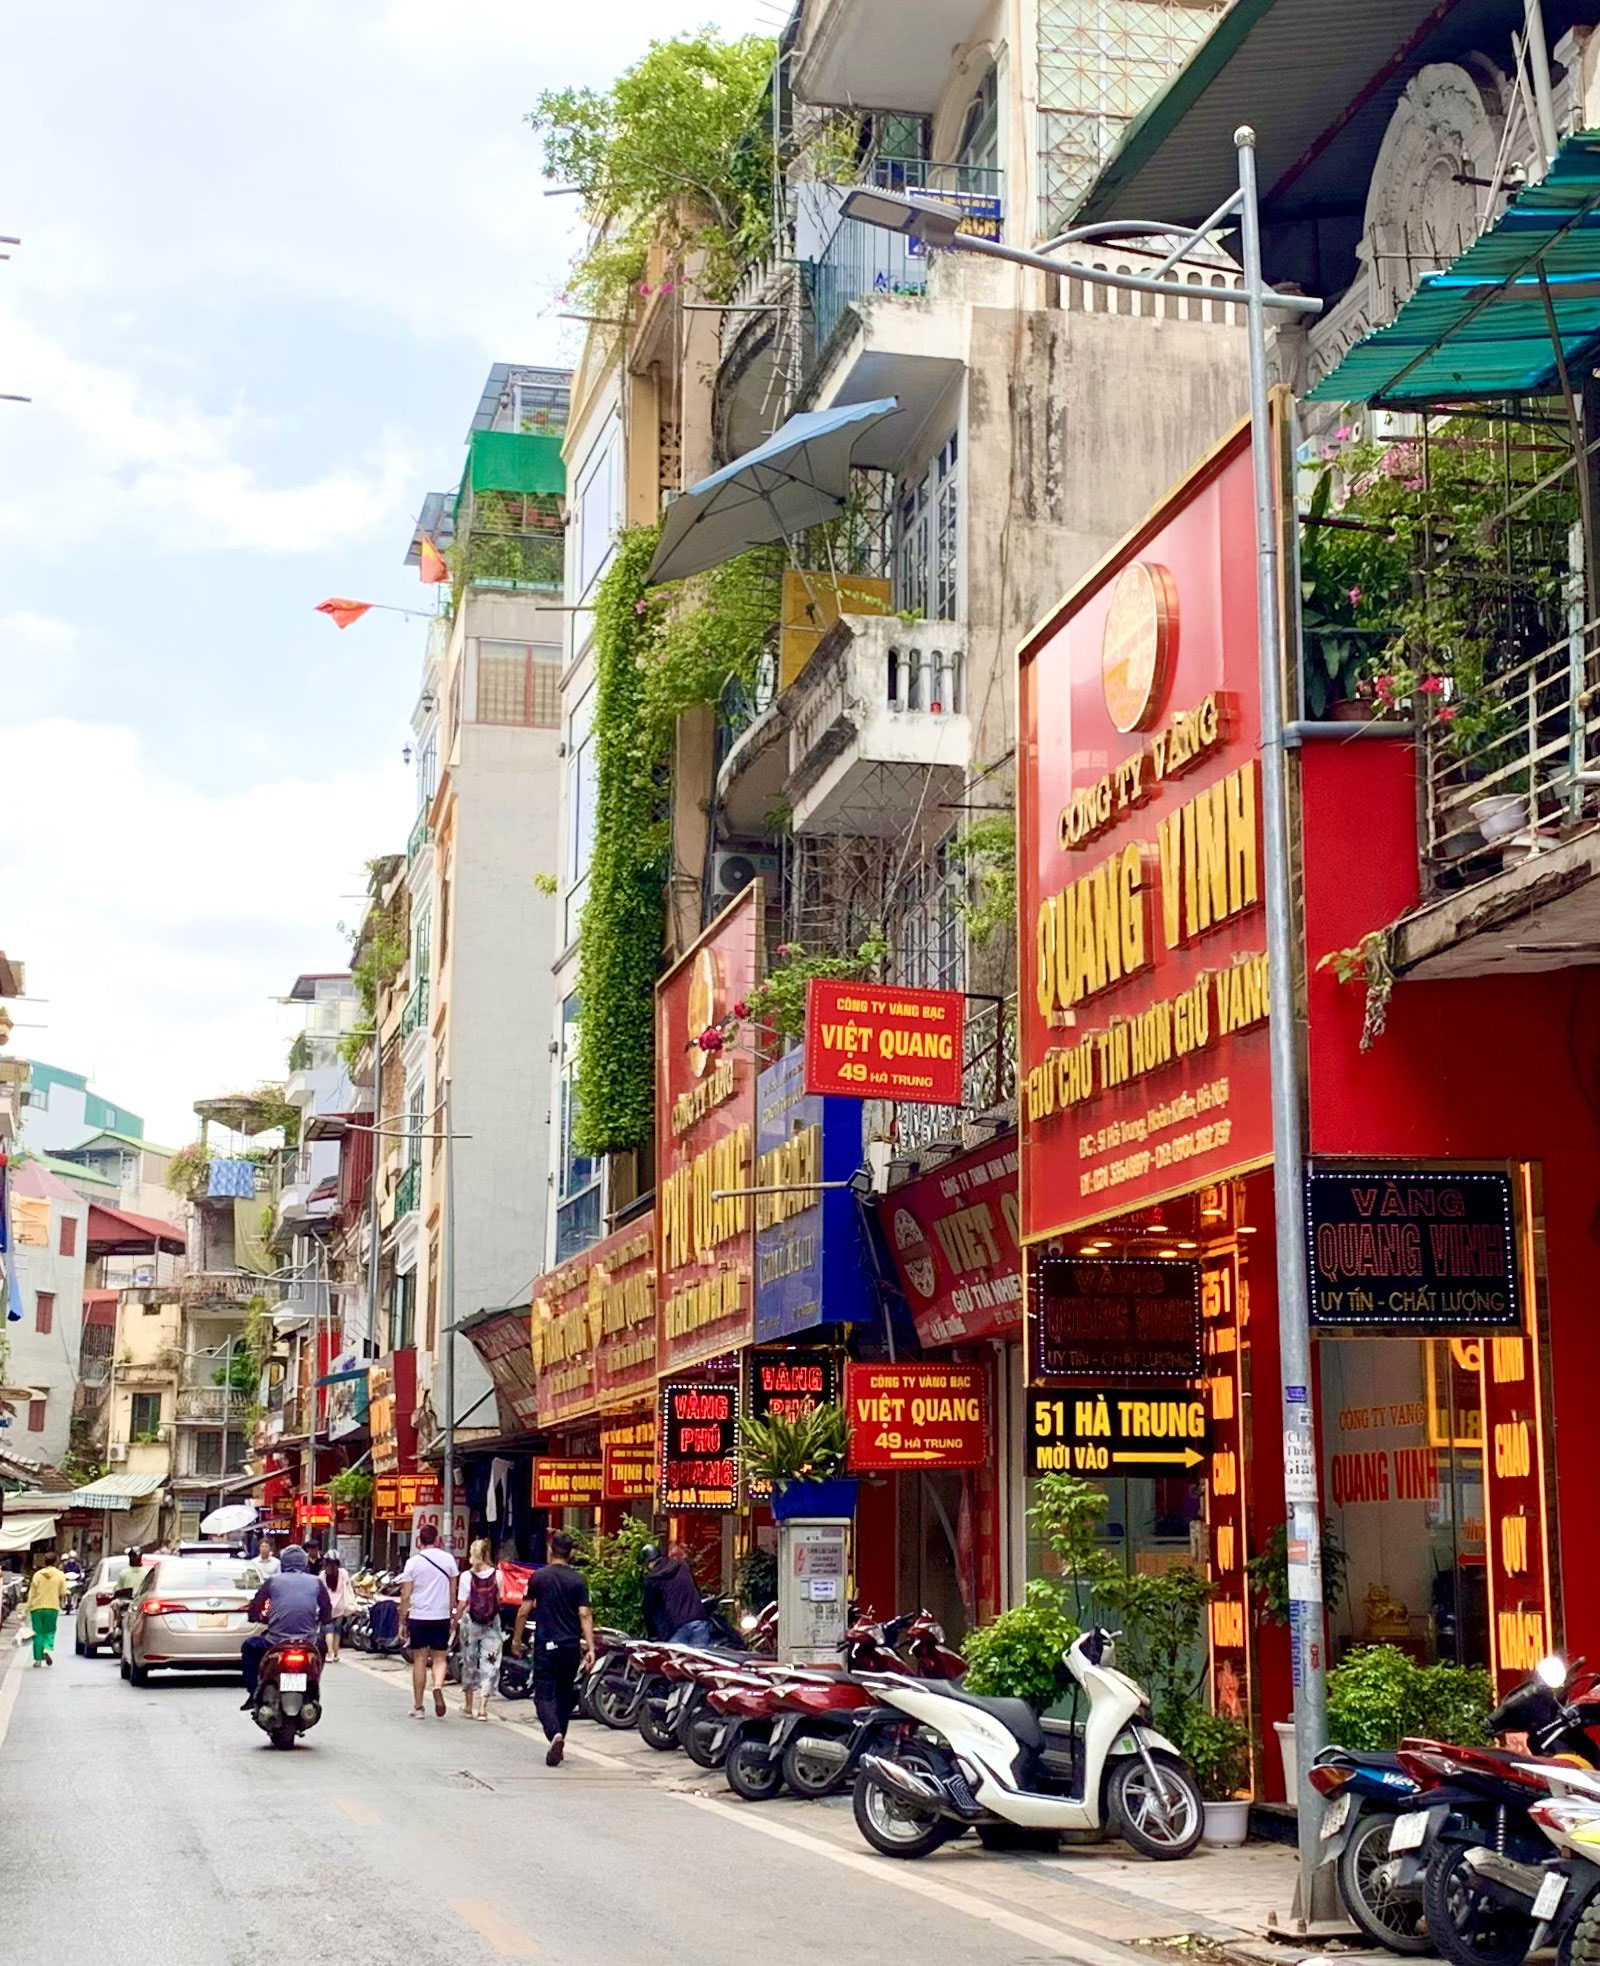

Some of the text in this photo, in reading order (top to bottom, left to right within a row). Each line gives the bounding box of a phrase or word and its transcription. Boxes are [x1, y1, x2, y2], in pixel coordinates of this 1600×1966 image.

[1115, 748, 1145, 810] TY
[1037, 760, 1258, 1028] QUANG VINH
[837, 996, 945, 1021] CÔNG TY VÀNG BẠC
[821, 1019, 952, 1060] VIỆT QUANG
[838, 1063, 933, 1087] 49 HÀ TRUNG
[1351, 1181, 1465, 1216] VÀNG
[933, 1196, 999, 1282] VIỆT
[1317, 1223, 1504, 1282] QUANG VINH
[1320, 1291, 1343, 1312] UY
[1347, 1287, 1374, 1312] TÍN
[1389, 1285, 1437, 1312] CHẤT
[1442, 1289, 1505, 1317] LƯỢNG
[870, 1374, 971, 1390] CÔNG TY VÀNG BẠC
[674, 1390, 728, 1420] VÀNG
[857, 1392, 980, 1429] VIỆT QUANG
[1035, 1394, 1205, 1437] 51 HÀ TRUNG
[680, 1424, 720, 1452] PHÚ
[874, 1432, 963, 1449] 49 HÀ TRUNG
[1036, 1441, 1109, 1469] MỜI VÀO
[668, 1460, 733, 1488] QUANG
[1332, 1448, 1438, 1508] QUANG VINH
